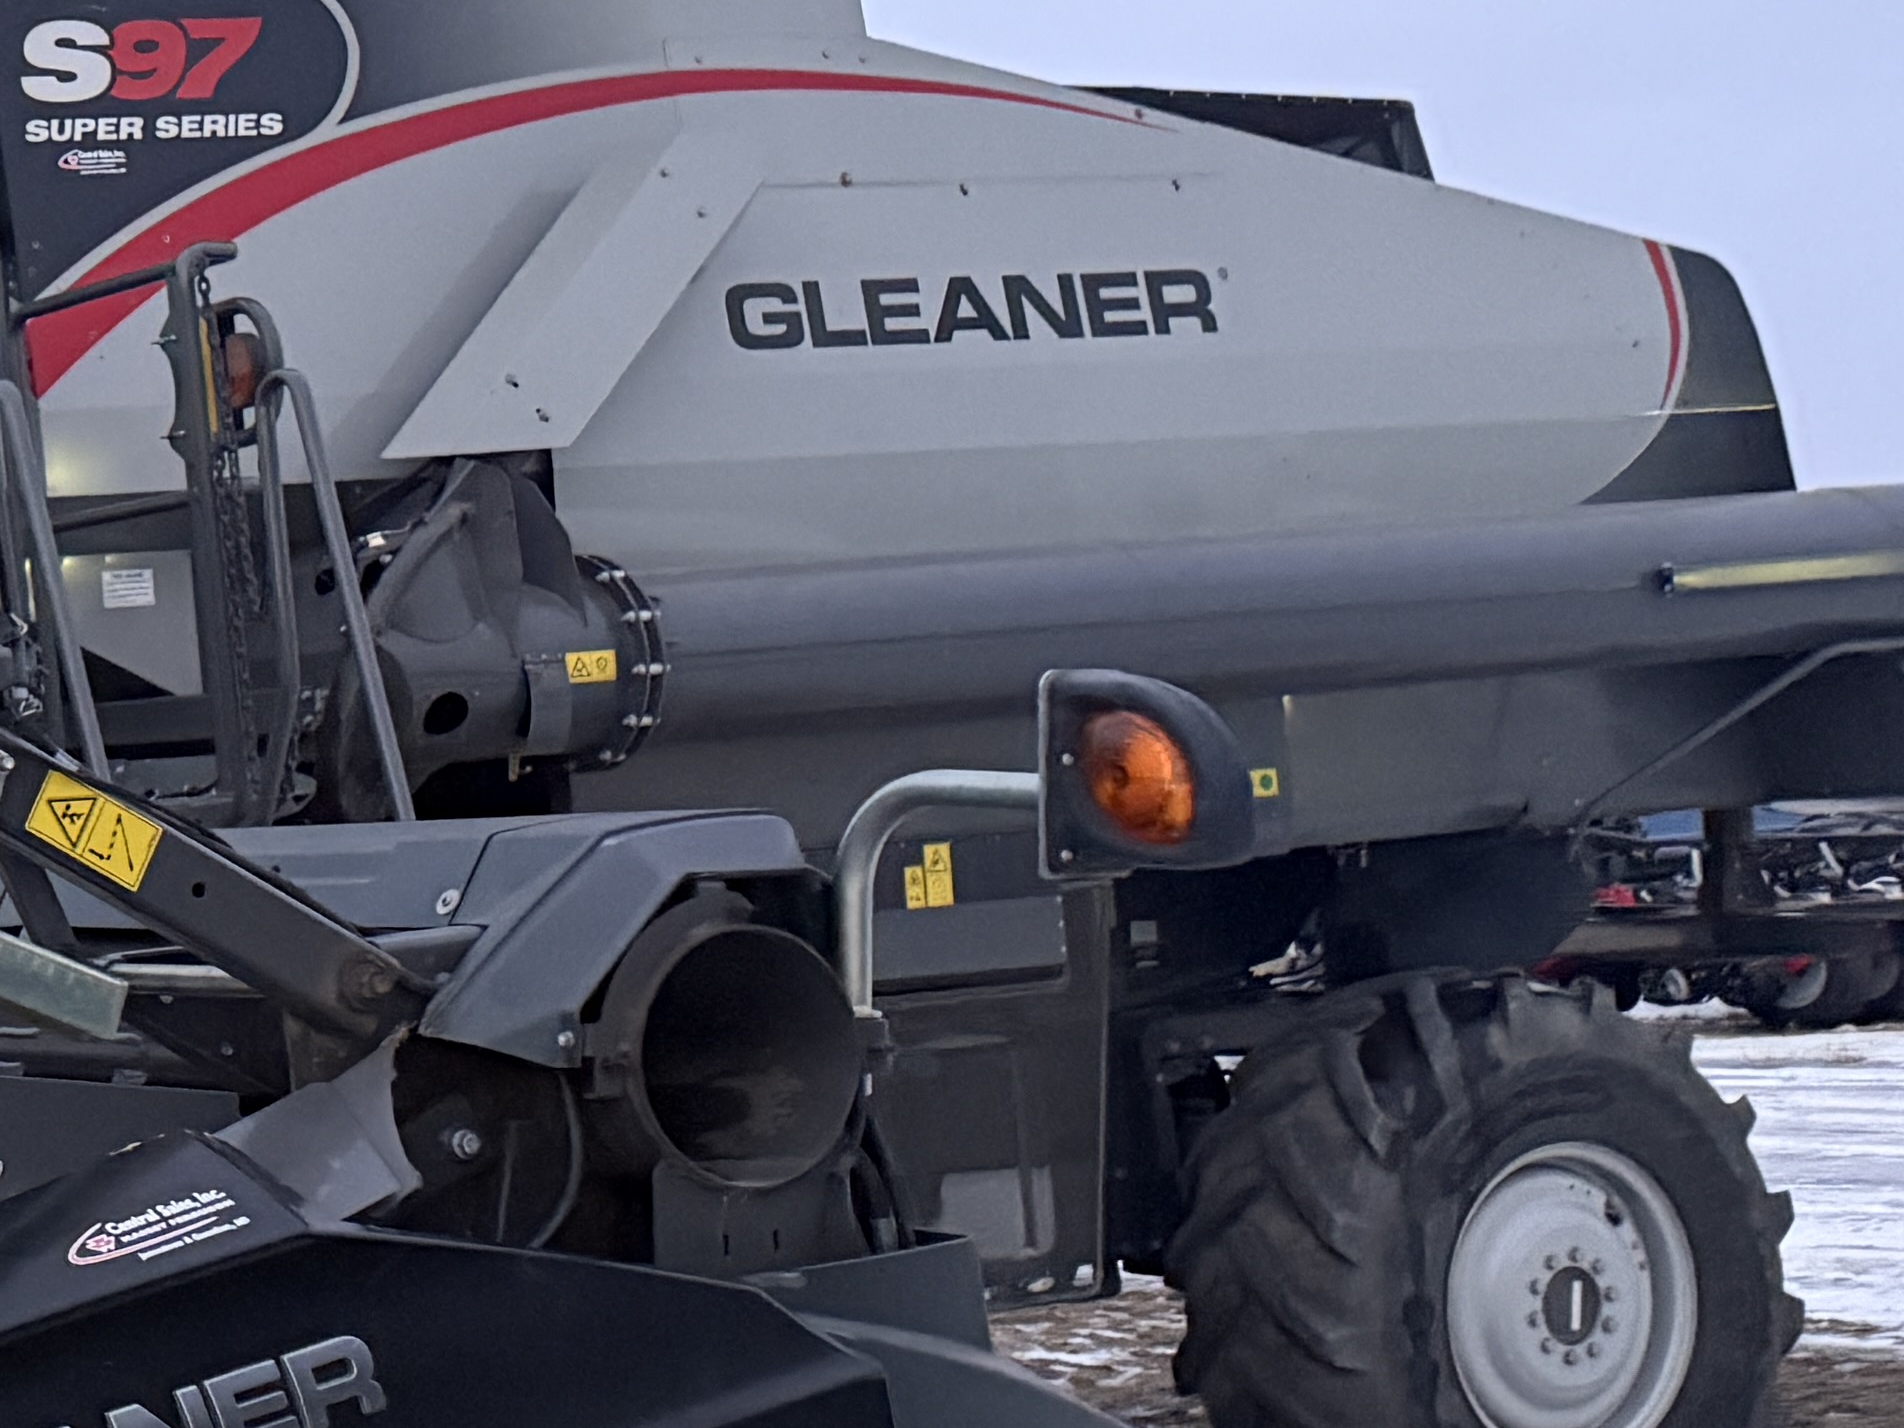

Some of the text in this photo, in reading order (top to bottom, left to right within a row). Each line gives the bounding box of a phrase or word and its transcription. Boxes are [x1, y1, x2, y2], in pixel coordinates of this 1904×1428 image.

[20, 18, 262, 103] S97
[25, 114, 282, 143] SUPER SERIES
[725, 269, 1218, 350] GLEANER
[105, 1208, 161, 1234] Central
